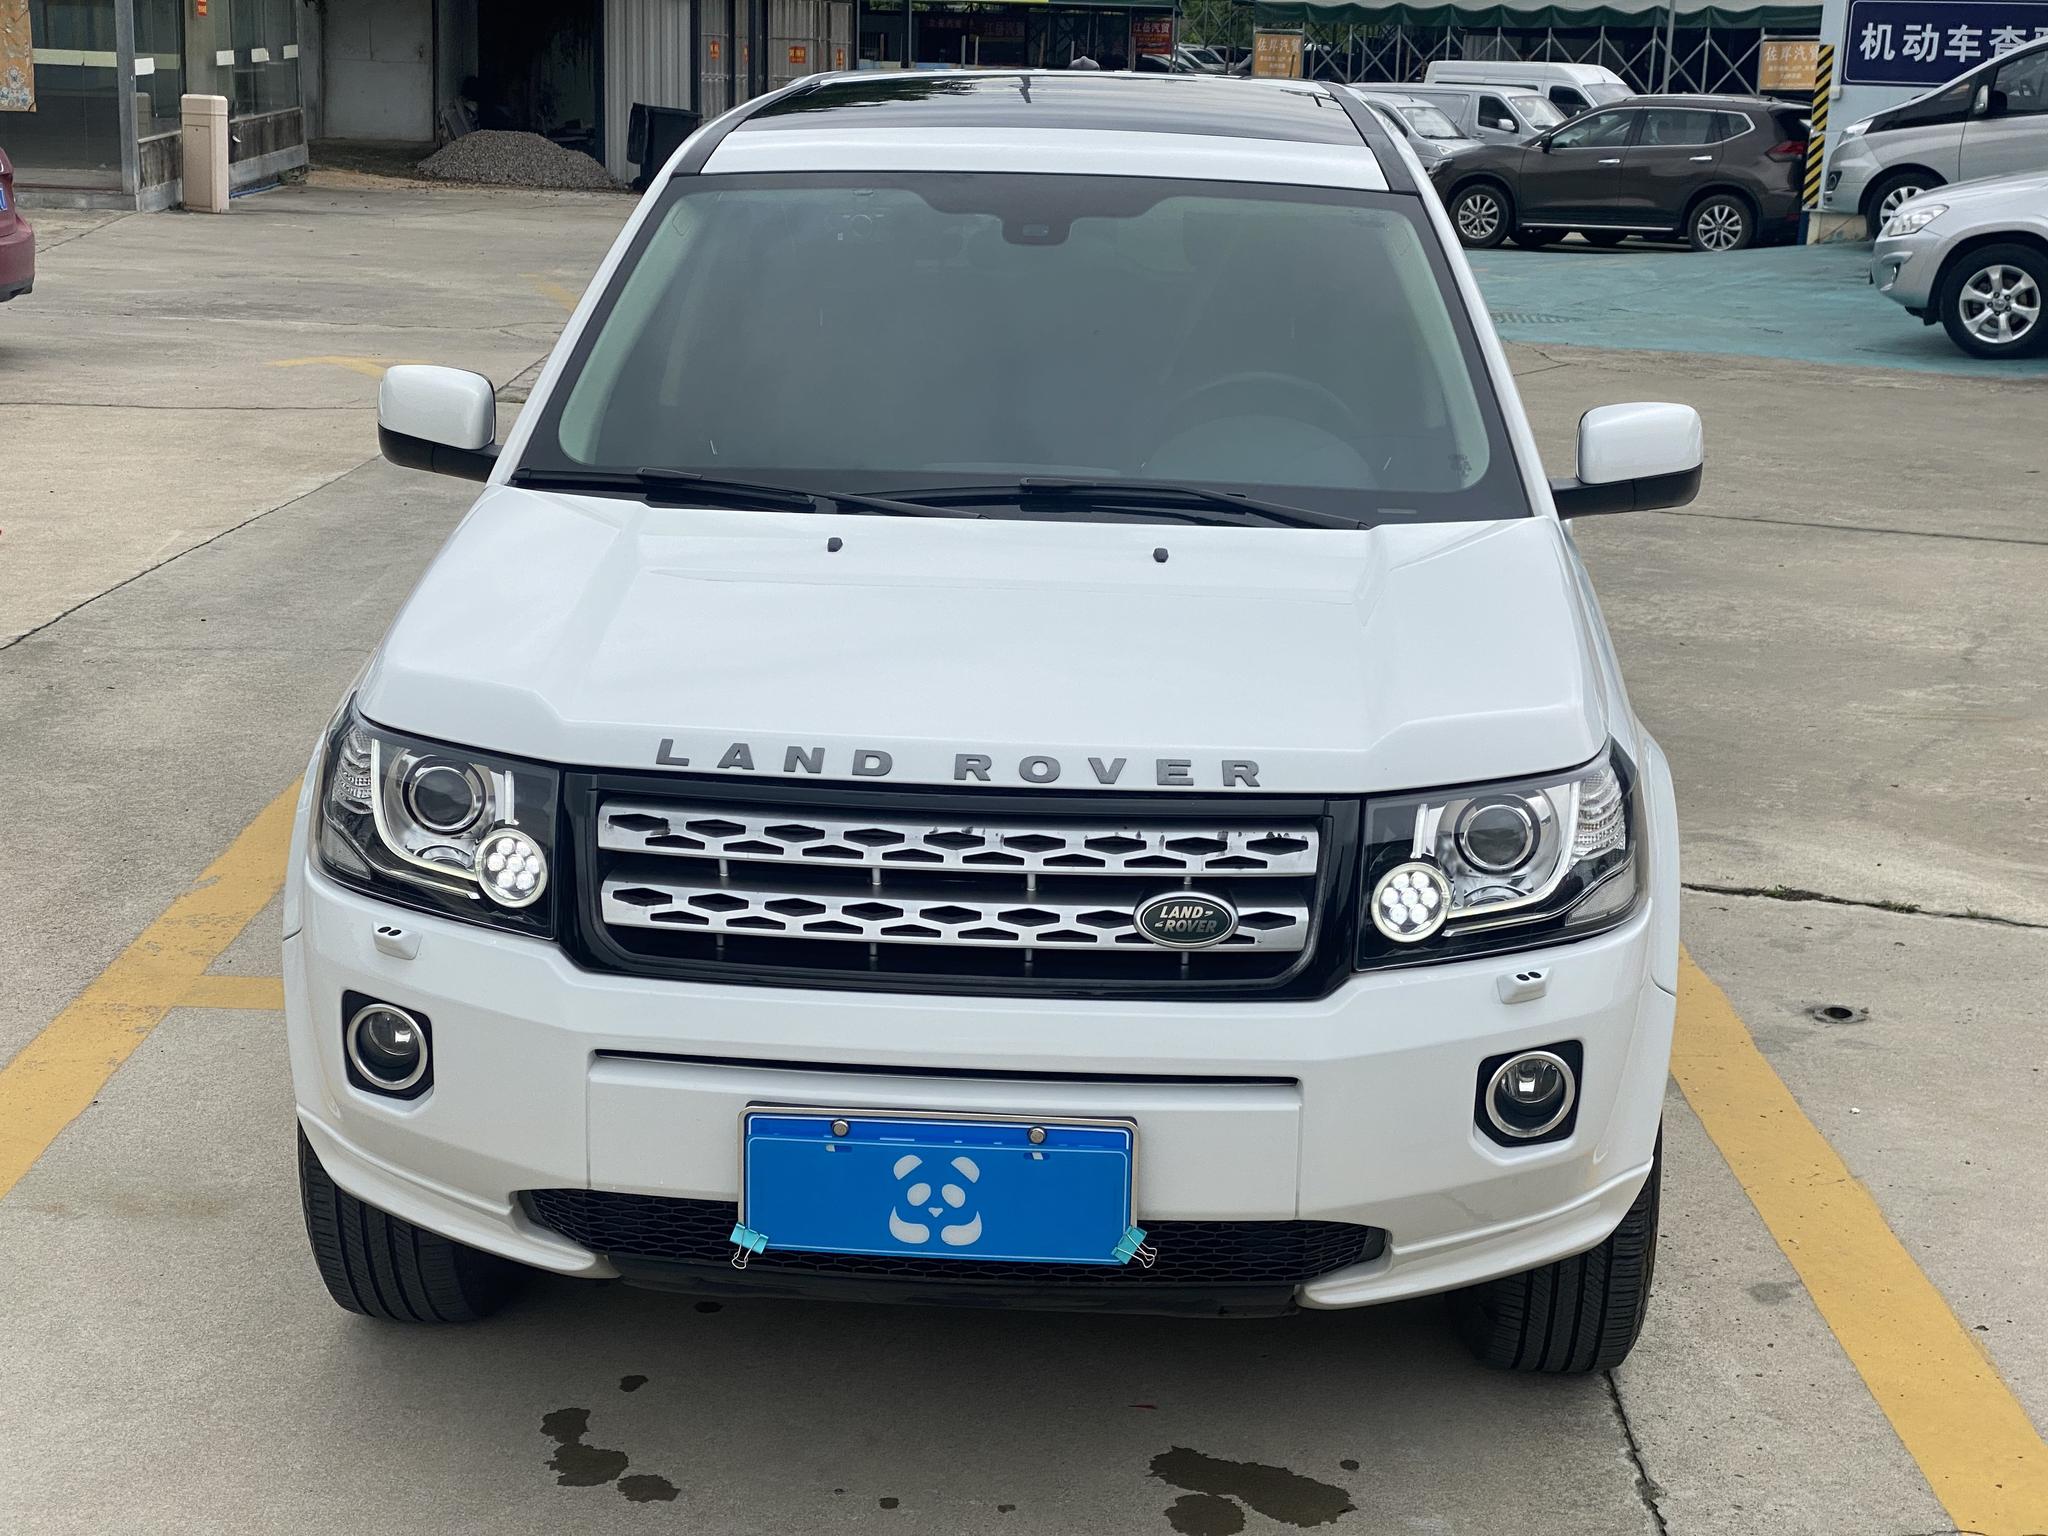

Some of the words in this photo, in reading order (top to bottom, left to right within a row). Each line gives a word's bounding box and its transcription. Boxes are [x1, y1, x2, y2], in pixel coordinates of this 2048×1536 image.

[1859, 22, 2048, 63] 机动车查
[656, 738, 893, 777] LAND
[953, 753, 1261, 787] ROVER
[1160, 905, 1204, 919] LAND
[1164, 919, 1217, 933] ROVER
